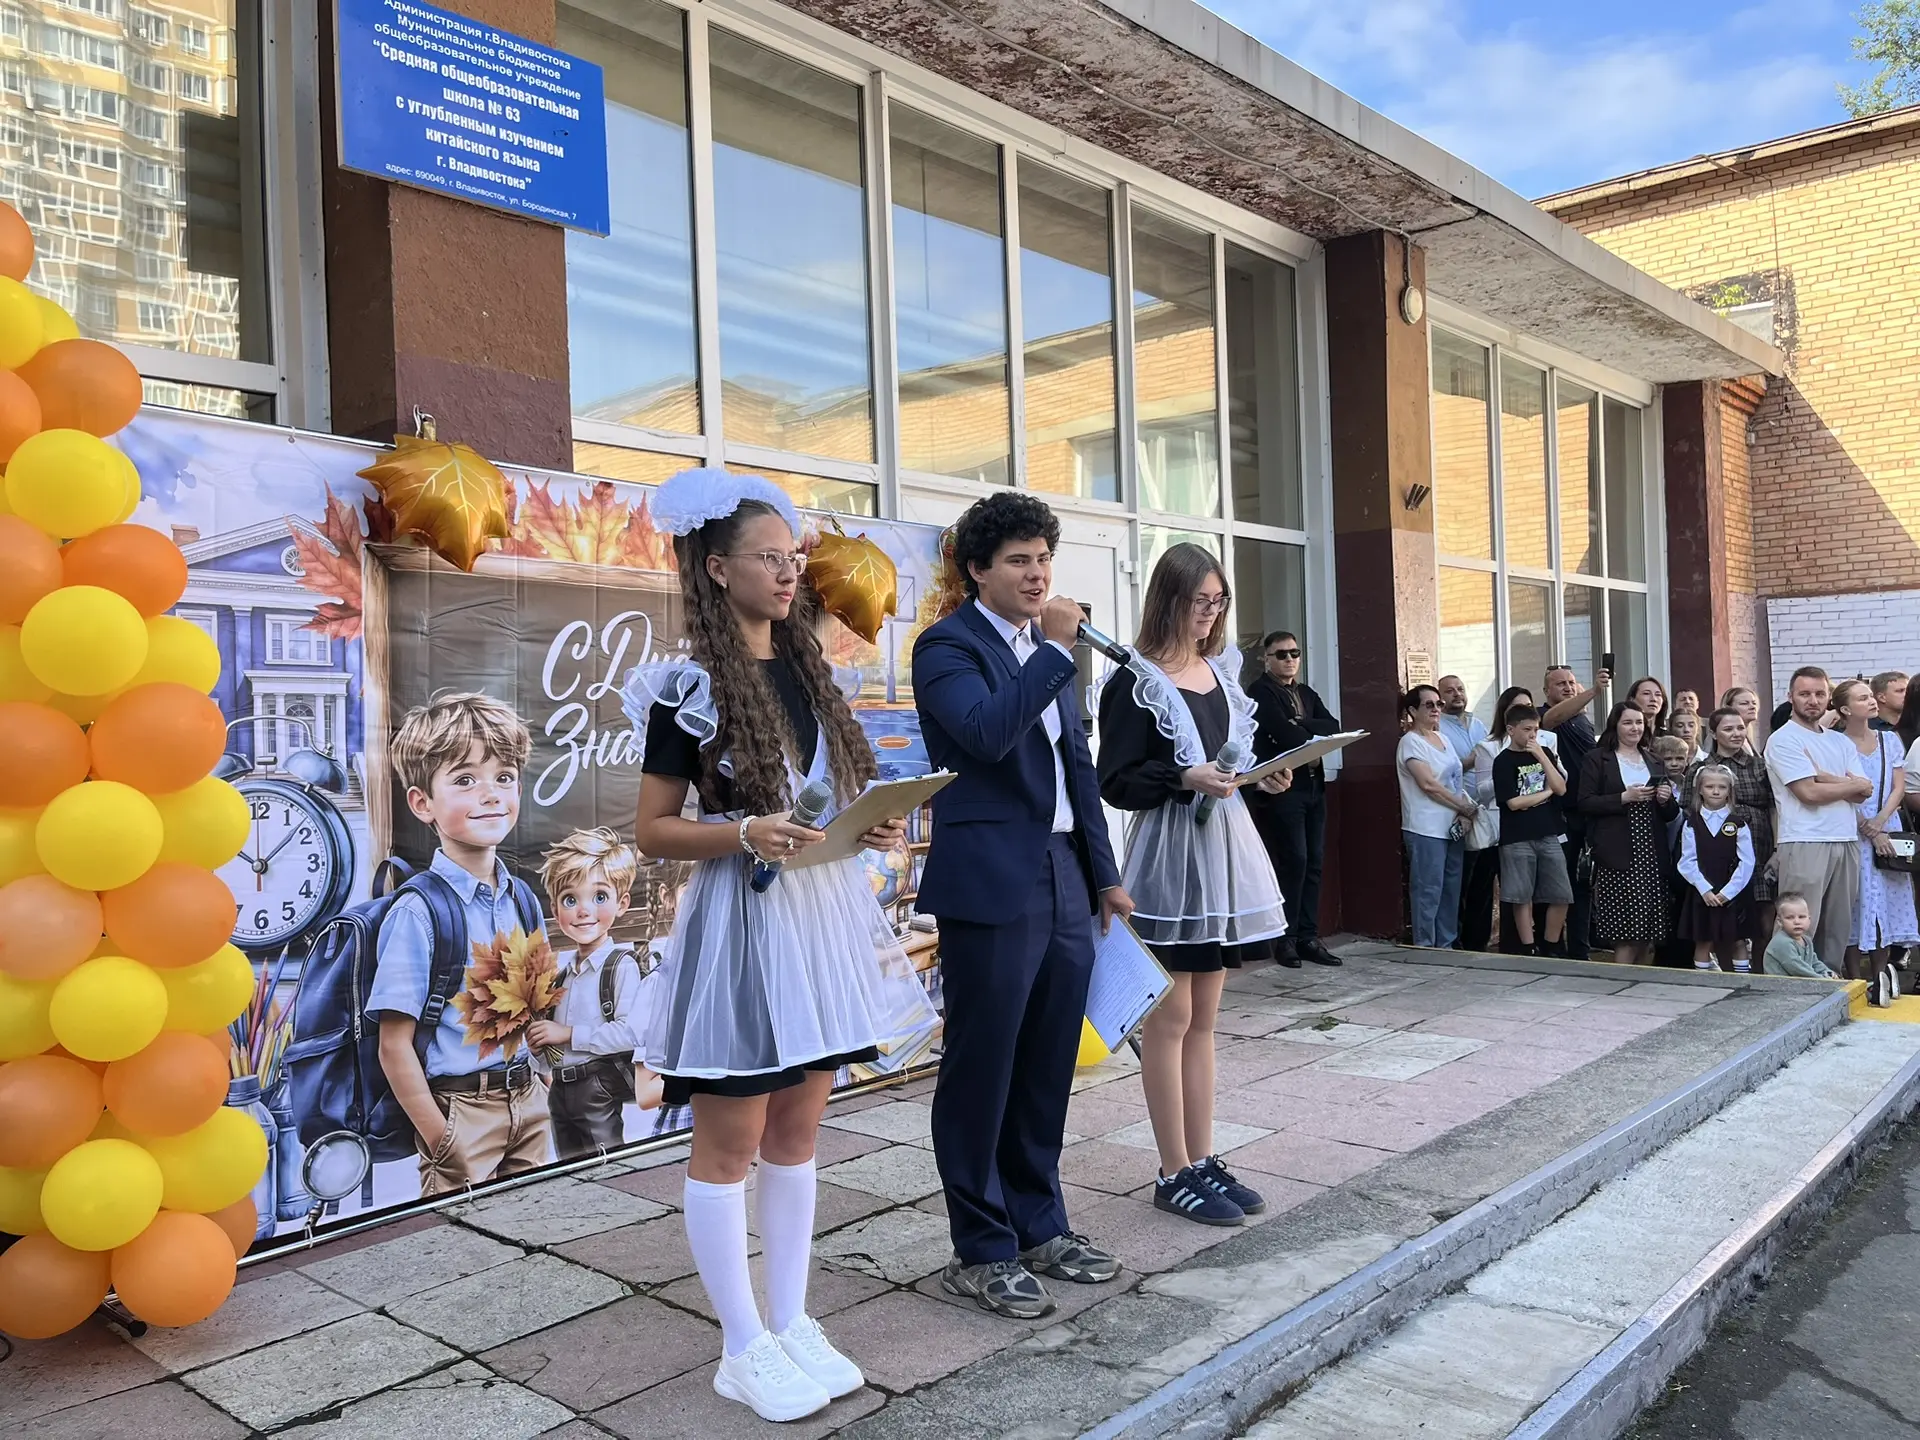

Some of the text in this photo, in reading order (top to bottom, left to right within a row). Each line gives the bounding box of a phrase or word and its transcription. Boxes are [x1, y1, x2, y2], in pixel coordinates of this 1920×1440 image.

[374, 23, 581, 100] общеобразовательное учреждение
[397, 14, 561, 80] Муниципальное бюджетное
[485, 32, 571, 70] г.Владивостока
[441, 64, 580, 121] общеобразовательная
[443, 87, 520, 123] школа № 63
[396, 95, 564, 158] с углубленным изучением
[425, 127, 541, 173] китайского языка
[436, 155, 447, 168] г.
[385, 163, 413, 176] адрес:
[415, 169, 448, 186] 690049,
[455, 180, 508, 203] Владивосток,
[521, 198, 571, 220] Бородинская,
[571, 212, 577, 220] 7
[542, 620, 593, 700] С
[250, 801, 271, 821] 12
[283, 808, 292, 827] 1
[298, 827, 313, 846] 2
[306, 852, 321, 873] 3
[298, 879, 314, 900] 4
[253, 908, 270, 930] 6
[281, 900, 297, 922] 5
